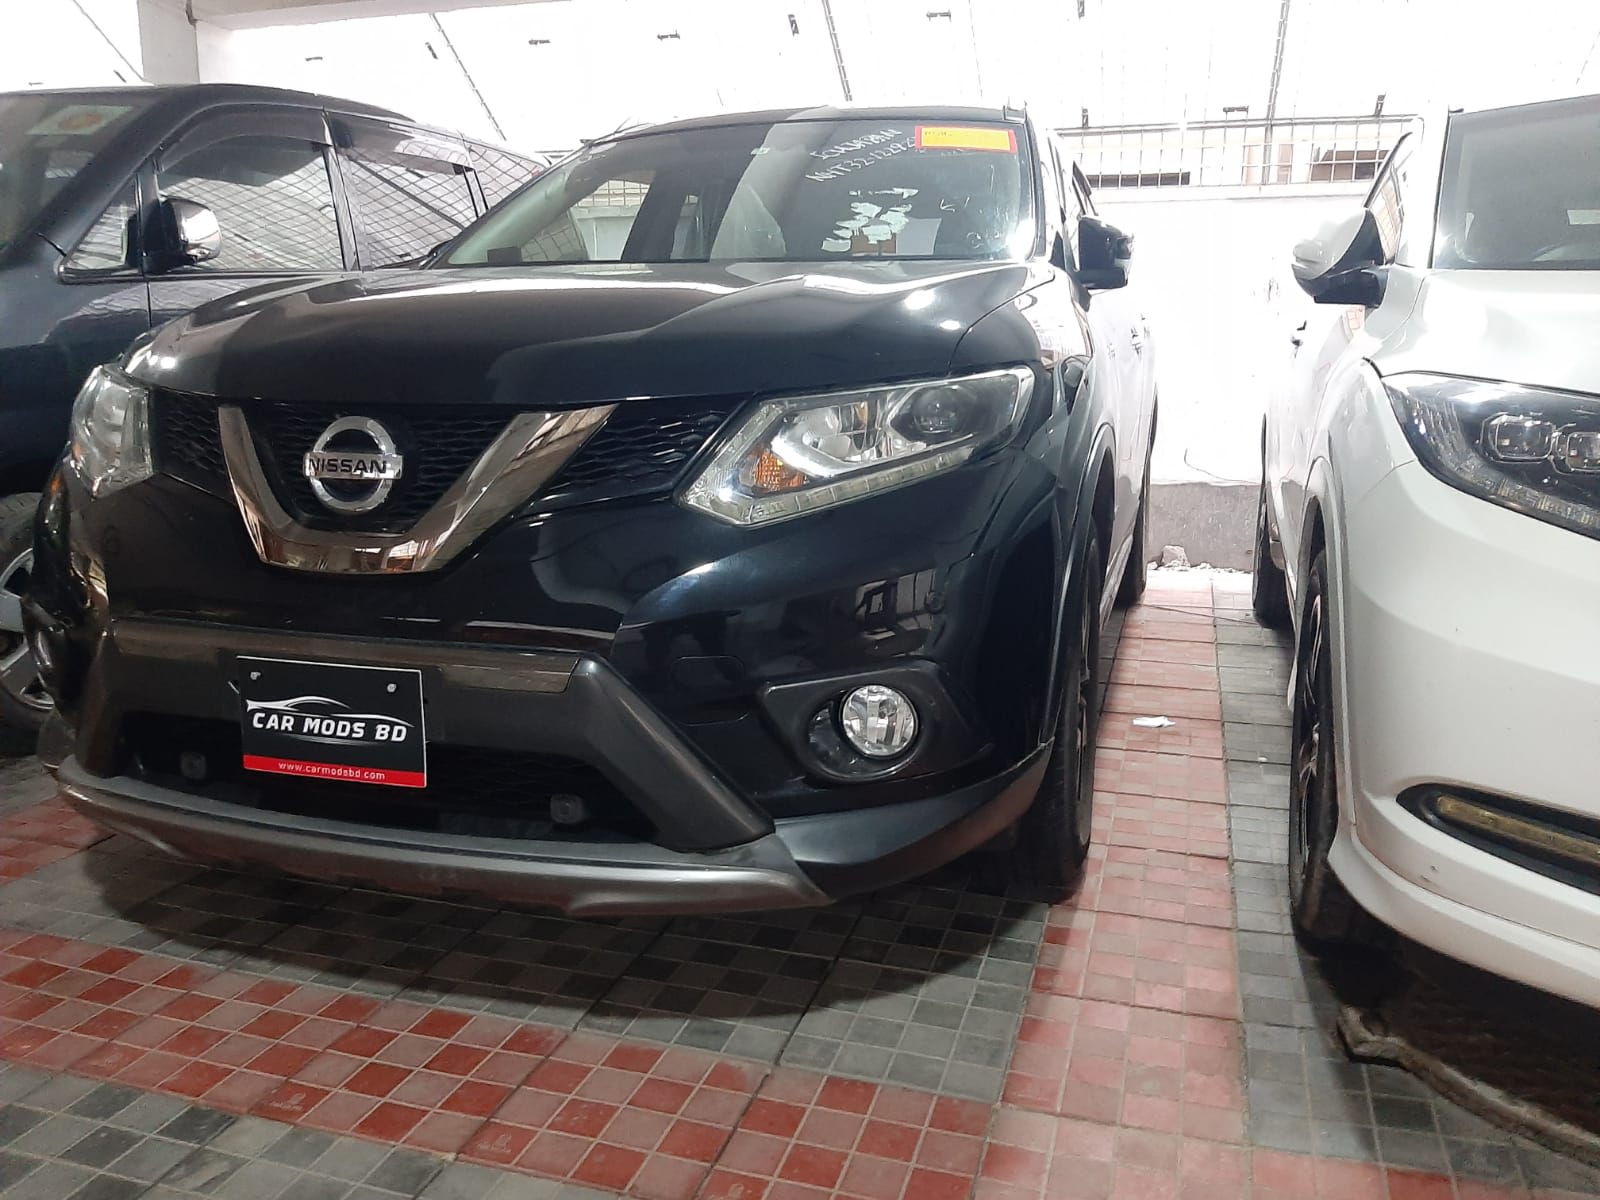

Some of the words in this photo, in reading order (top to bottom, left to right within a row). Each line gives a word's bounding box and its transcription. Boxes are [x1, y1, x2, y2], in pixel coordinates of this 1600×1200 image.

[309, 458, 387, 474] NISSAN
[252, 712, 295, 732] CAR
[302, 717, 366, 739] MODS
[375, 723, 408, 743] BD
[278, 762, 386, 781] www.carmodsbd.com
